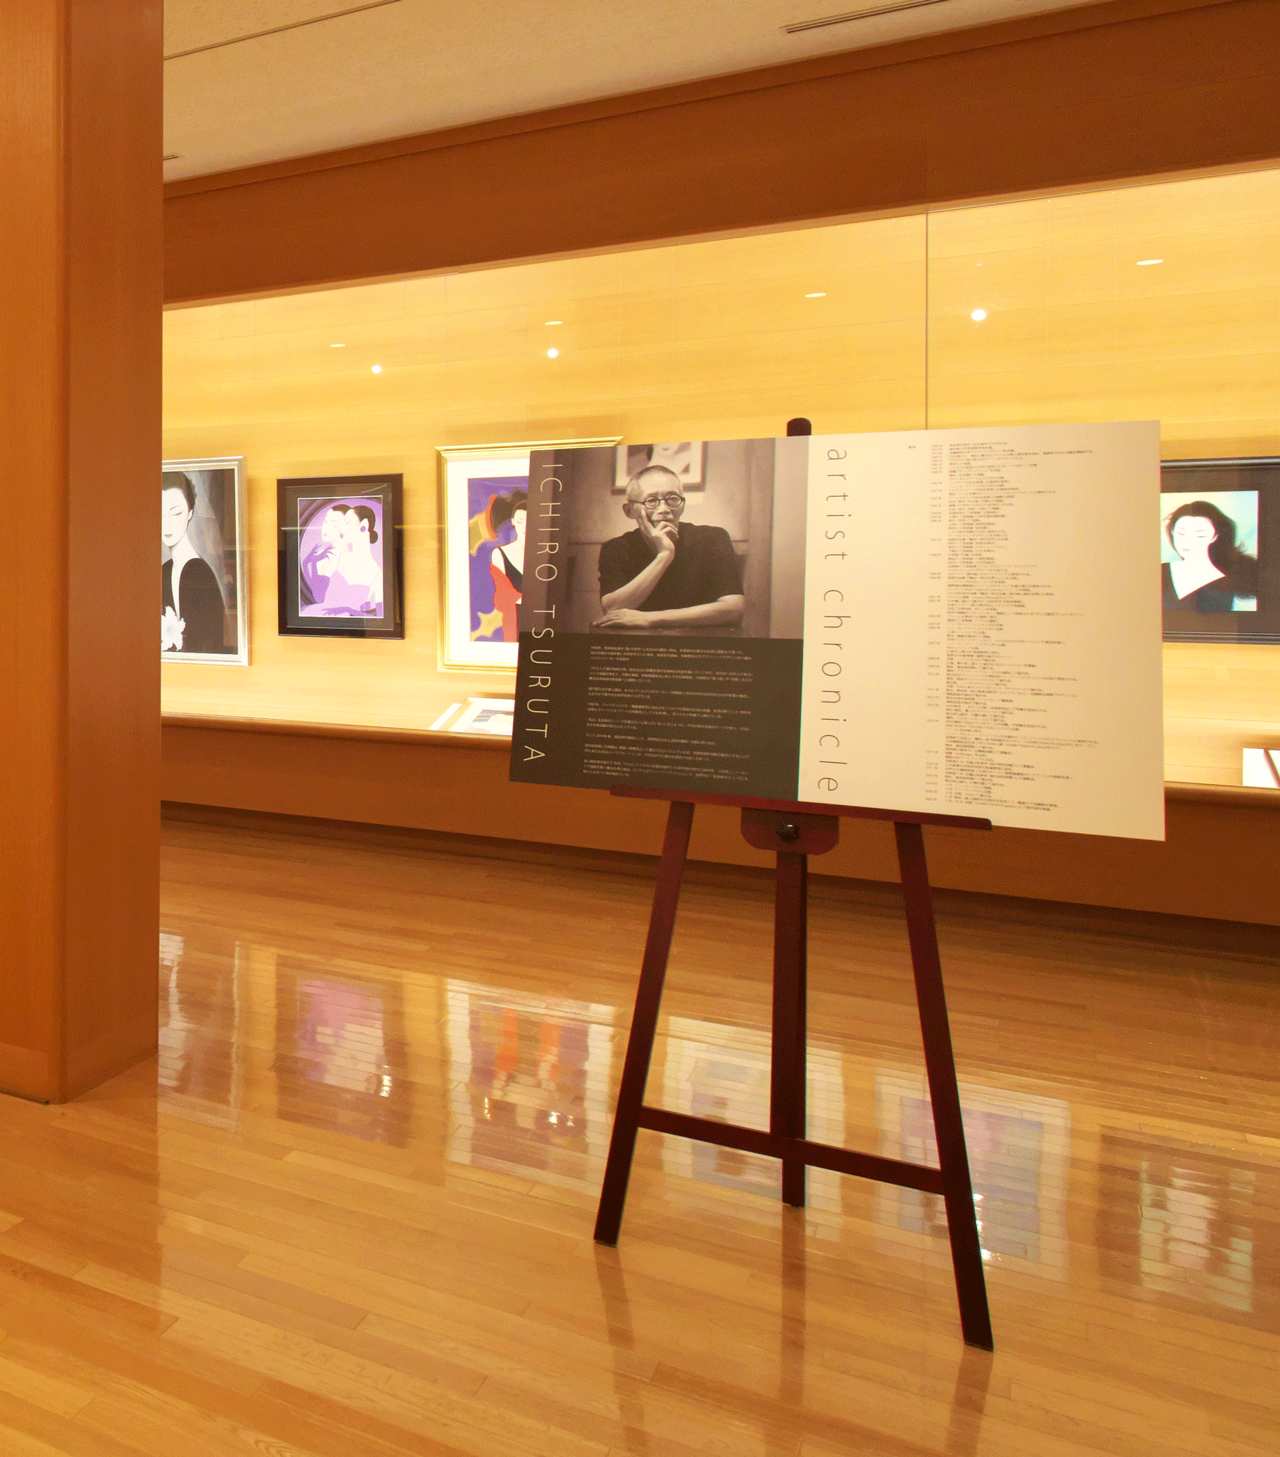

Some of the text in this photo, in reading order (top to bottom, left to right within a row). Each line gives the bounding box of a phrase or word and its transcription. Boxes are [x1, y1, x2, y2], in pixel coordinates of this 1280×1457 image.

[523, 463, 563, 762] ICHIRO TSURUTA
[817, 448, 852, 792] artist chronicle
